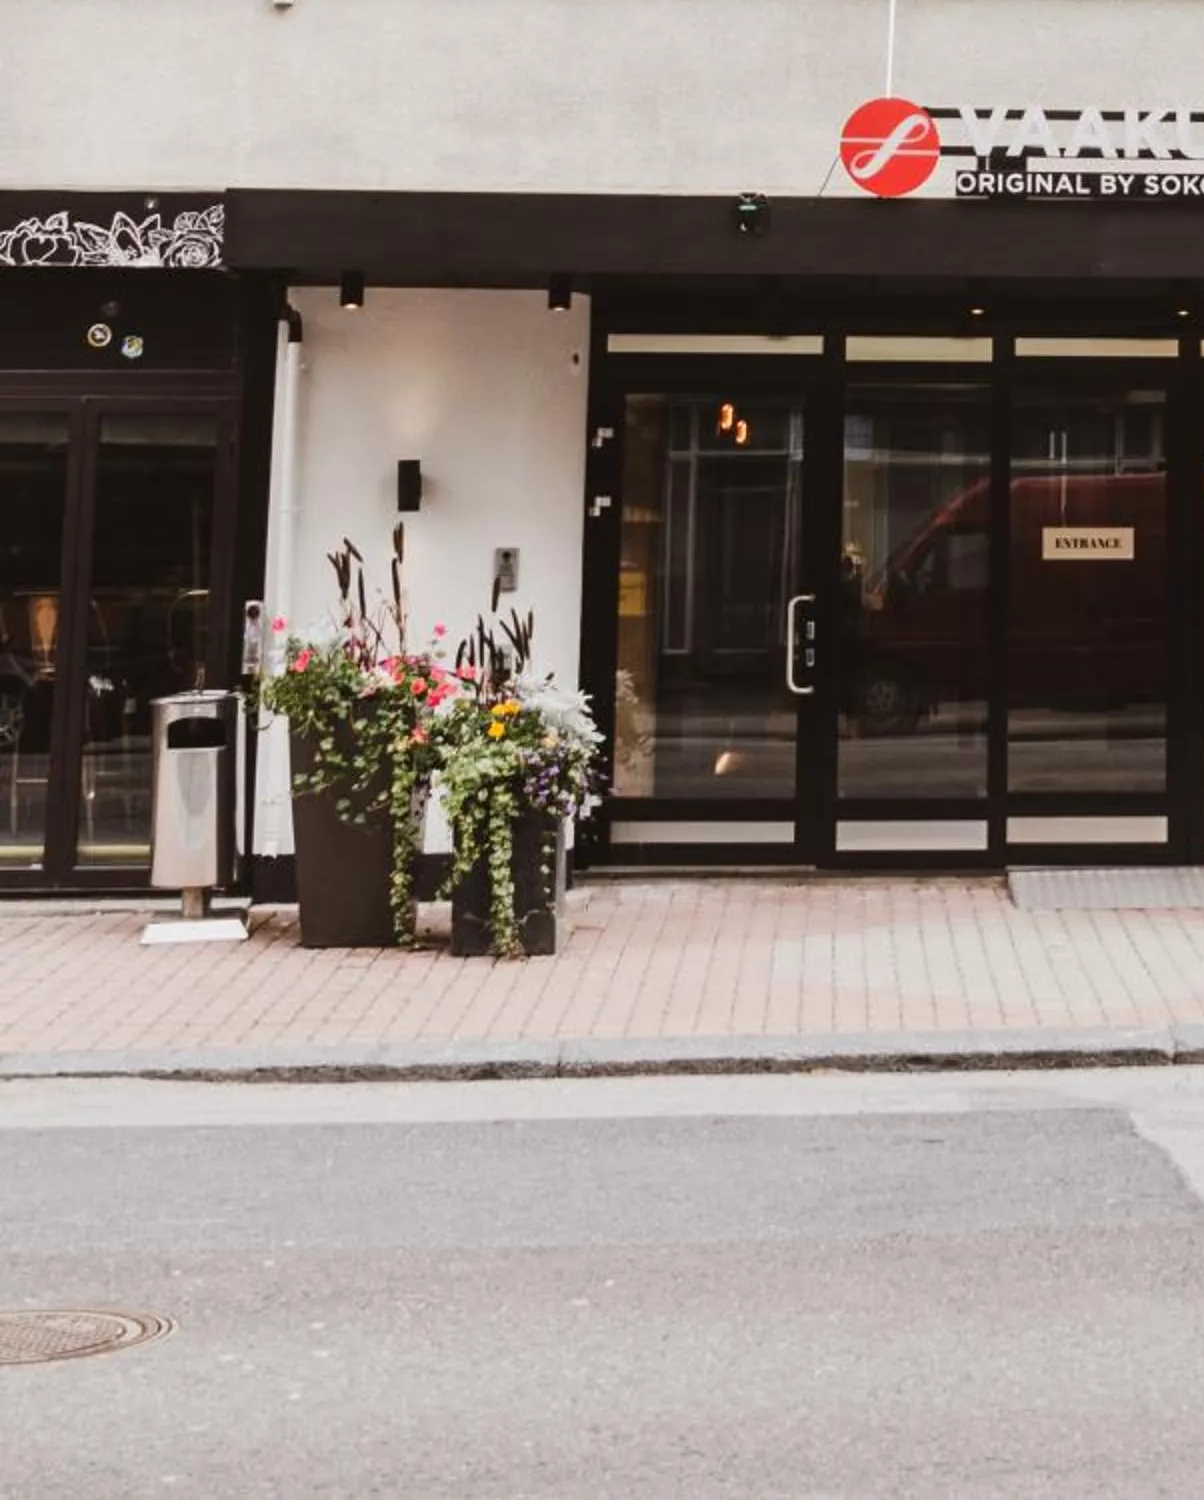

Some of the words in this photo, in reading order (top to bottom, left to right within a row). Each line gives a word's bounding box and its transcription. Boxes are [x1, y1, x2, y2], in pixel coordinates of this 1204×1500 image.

[957, 172, 1091, 195] ORIGINAL
[1100, 174, 1135, 195] BY
[1055, 537, 1123, 549] ENTRANCE
